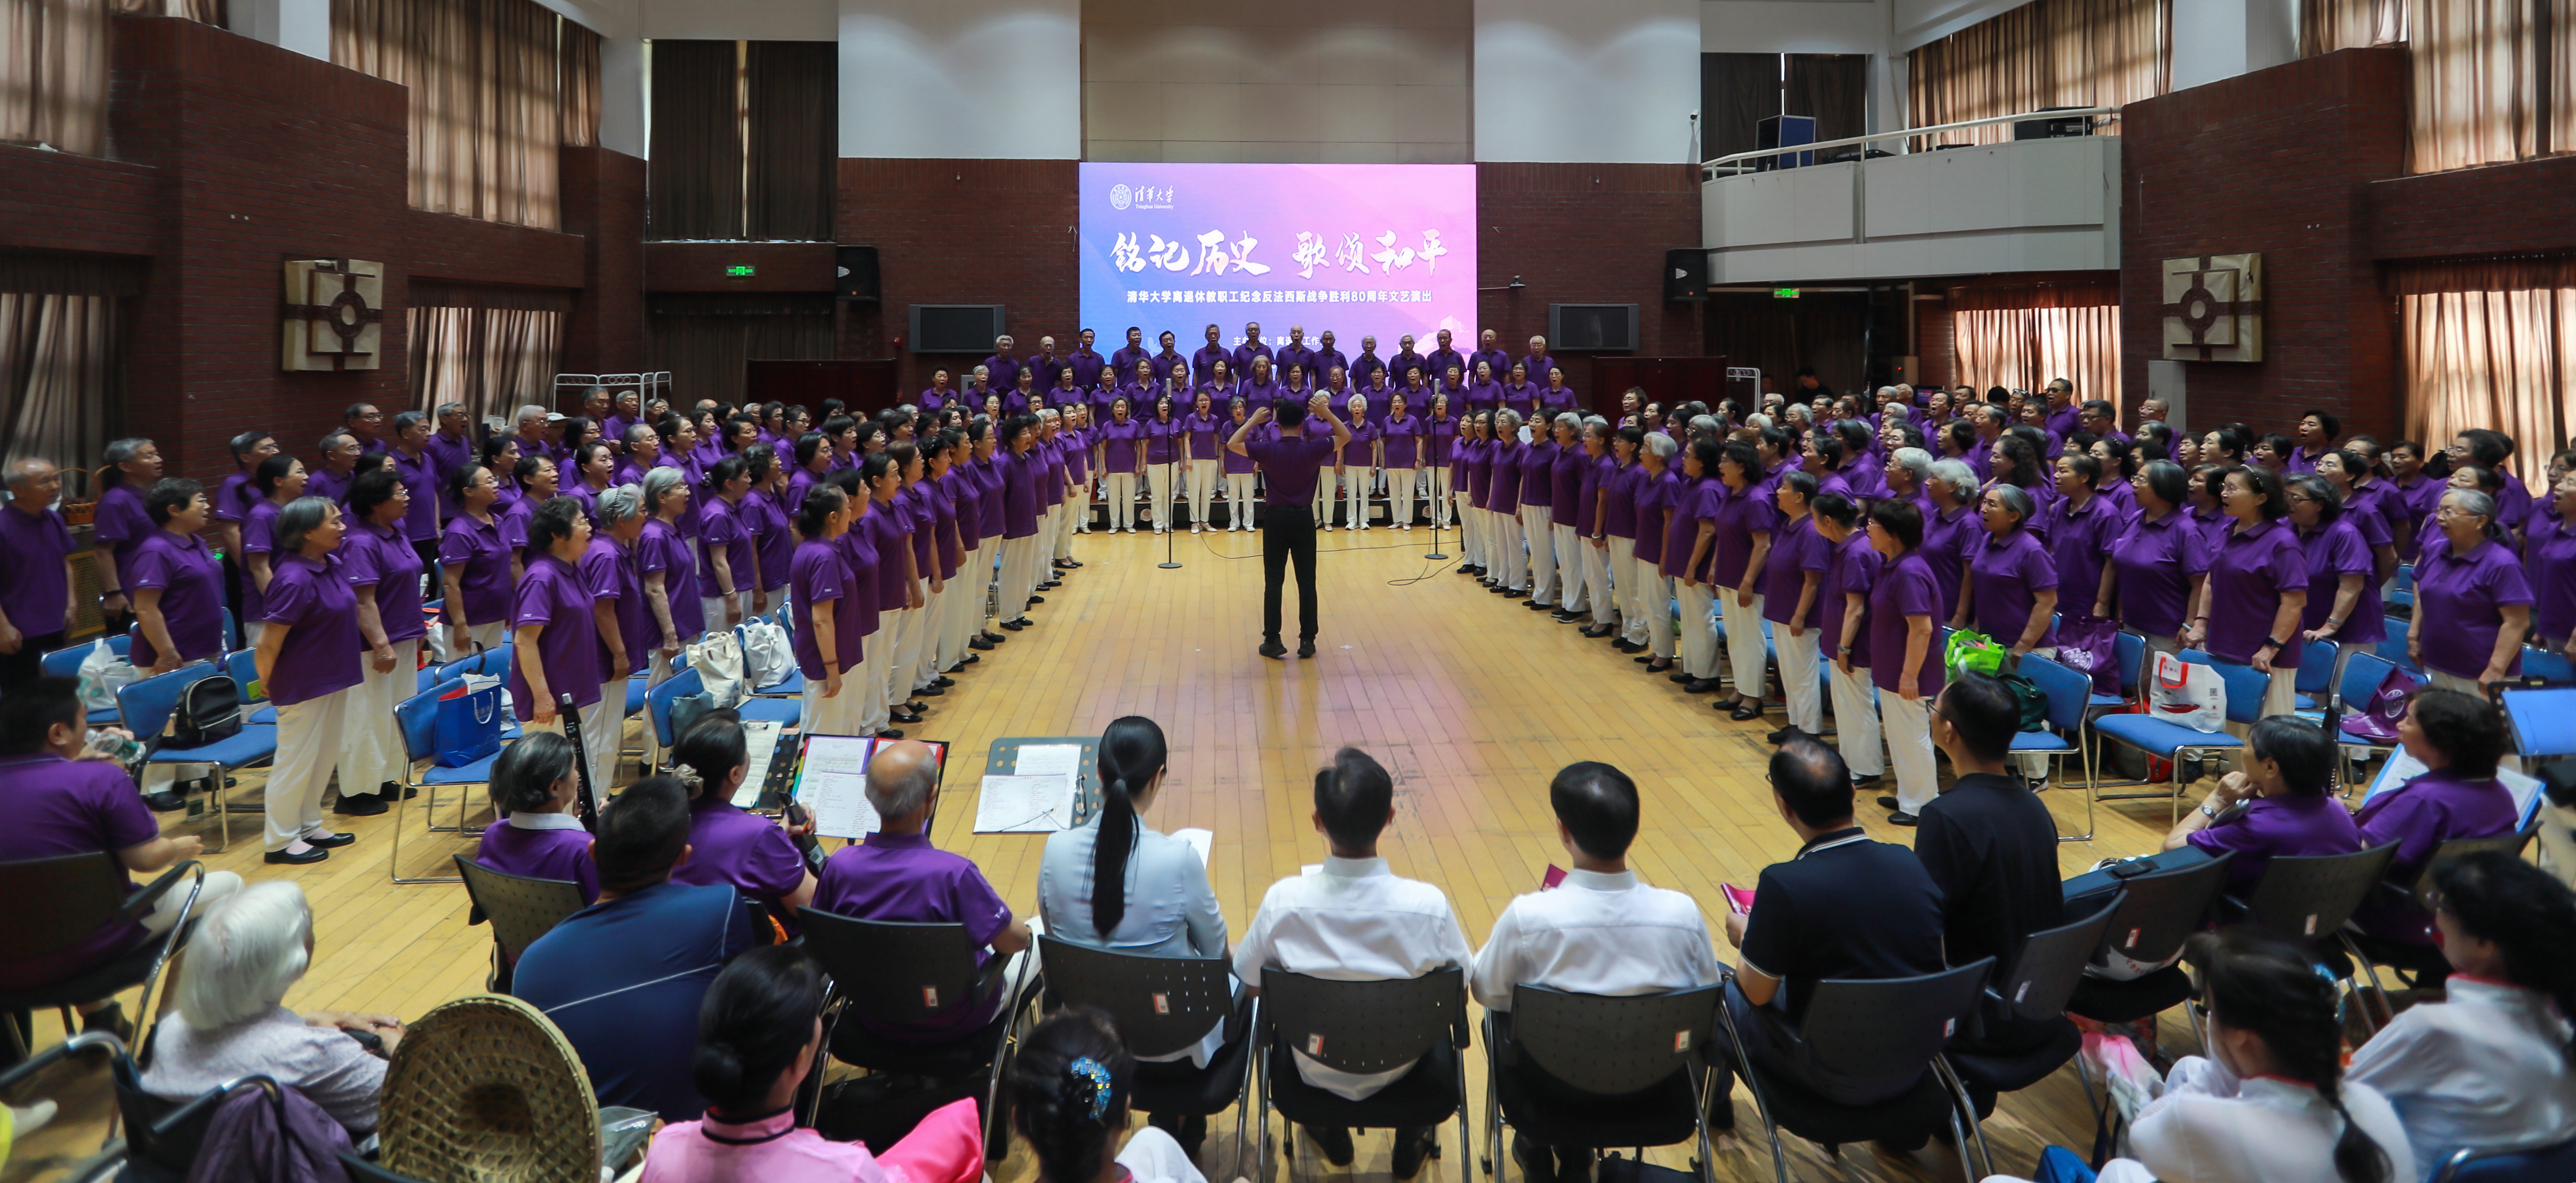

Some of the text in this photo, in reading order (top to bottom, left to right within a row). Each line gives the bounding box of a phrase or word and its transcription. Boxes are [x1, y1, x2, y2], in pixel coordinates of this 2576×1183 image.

[1110, 228, 1448, 279] 铭记历史 歌颂和平
[1127, 290, 1432, 303] 清华大学离退休教职工纪念反法西斯战争胜利80周年文艺演出
